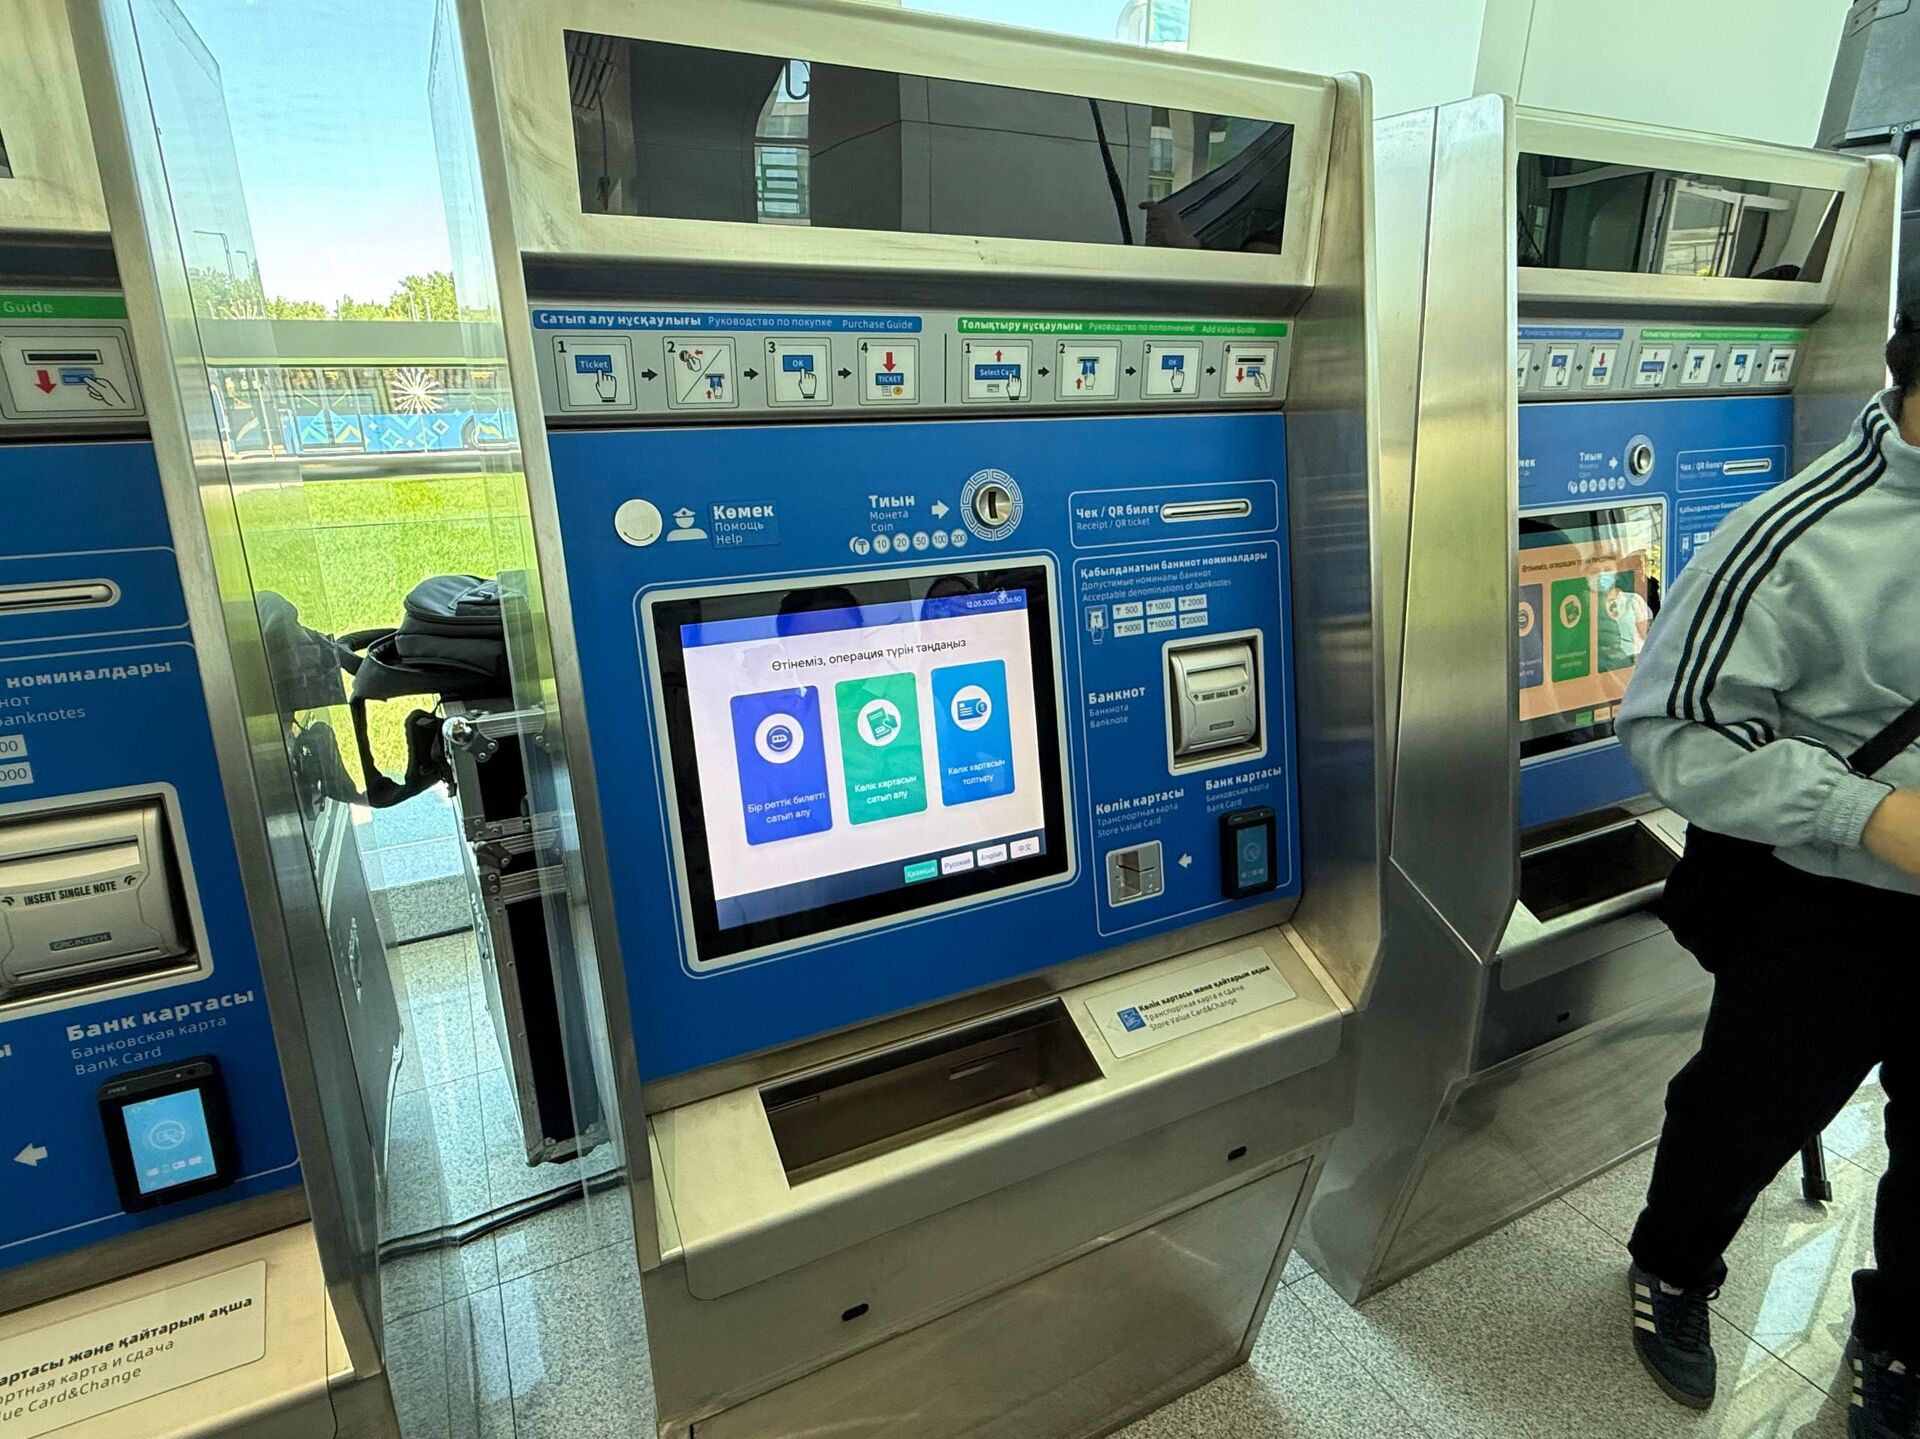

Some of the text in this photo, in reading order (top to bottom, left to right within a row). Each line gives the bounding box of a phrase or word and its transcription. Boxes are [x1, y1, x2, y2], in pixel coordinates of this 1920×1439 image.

[3, 301, 54, 313] Guide
[540, 313, 701, 327] Сатып алу нұсқаулығы
[708, 316, 774, 328] Руководство
[791, 319, 832, 329] покупке
[842, 319, 913, 329] Purchase Guide
[962, 320, 1082, 332] Толықтыру нұсқаулығы
[1088, 323, 1136, 332] Руководство
[1201, 326, 1216, 334] Add
[558, 341, 566, 354] 1
[667, 341, 676, 354] 2
[768, 342, 776, 354] 3
[860, 342, 869, 354] 4
[965, 343, 971, 353] 1
[1060, 344, 1066, 354] 2
[1146, 344, 1152, 354] 3
[1225, 344, 1231, 354] 4
[579, 359, 608, 370] Ticket
[878, 375, 901, 383] TICKET
[869, 494, 915, 507] Тиын
[713, 503, 774, 519] Көмек
[870, 510, 909, 521] Монета
[1076, 508, 1098, 519] Чек
[1108, 505, 1124, 517] QR
[1126, 504, 1160, 515] билет
[715, 521, 764, 534] Помощь
[871, 521, 894, 532] Coin
[1076, 519, 1108, 532] Receipt
[1115, 519, 1127, 528] QR
[1128, 517, 1150, 526] ticket
[716, 533, 743, 545] Help
[877, 540, 887, 548] 10
[897, 538, 907, 547] 20
[916, 537, 926, 545] 50
[934, 535, 947, 543] 100
[953, 534, 965, 542] 200
[1080, 551, 1268, 579] Қабылданатын банкнот номиналдары
[1081, 568, 1212, 591] Допустимые номиналы банкнот
[1082, 578, 1232, 603] Acceptable denominations of banknotes
[1154, 601, 1171, 610] 1000
[1187, 597, 1204, 606] 2000
[1125, 605, 1138, 614] 500
[1124, 623, 1142, 633] 5000
[772, 639, 966, 671] Өтінеміз, операция түрін таңдаңыз
[6, 660, 172, 689] номиналдары
[1088, 686, 1146, 705] Банкнот
[1089, 704, 1129, 717] Банкнота
[1090, 715, 1128, 728] Banknote
[948, 759, 1005, 776] Көлік картасын
[854, 775, 917, 793] Көлік картасын
[1205, 766, 1282, 791] Банк картасы
[866, 790, 908, 804] сатып алу
[1206, 782, 1270, 802] Банковская карта
[747, 792, 825, 813] Бір реттік билетті
[1096, 788, 1185, 815] Көлік картасы
[1207, 798, 1242, 813] Bank Card
[766, 809, 811, 824] сатып алу
[1097, 802, 1178, 828] Транспортная карта
[1097, 816, 1161, 837] Store Value Card
[24, 880, 118, 907] INSERT SINGLE NOTE
[1138, 998, 1161, 1012] Көлік
[1162, 990, 1194, 1007] картасы
[1214, 971, 1250, 988] қайтарым
[1144, 1000, 1197, 1022] Транспортная
[1197, 993, 1218, 1007] карта
[1224, 985, 1245, 997] сдача
[66, 990, 254, 1042] Банк картасы
[1150, 997, 1238, 1031] Store Value Card&Change
[71, 1016, 227, 1060] Банковская карта
[75, 1045, 162, 1076] Bank Card
[0, 1296, 253, 1386] артасы және қайтарым ақша
[60, 1361, 108, 1386] карта
[112, 1357, 122, 1368] и
[126, 1340, 174, 1364] сдача
[28, 1367, 142, 1412] Card&Change
